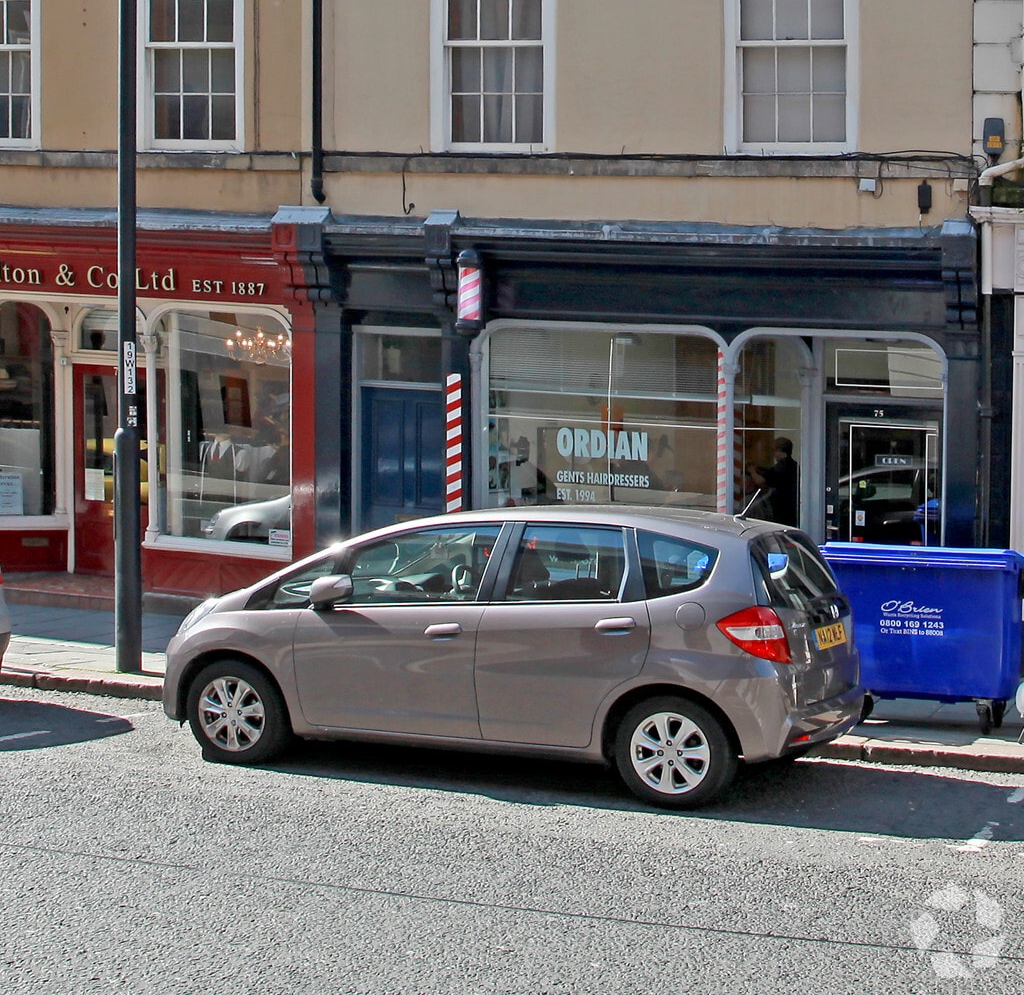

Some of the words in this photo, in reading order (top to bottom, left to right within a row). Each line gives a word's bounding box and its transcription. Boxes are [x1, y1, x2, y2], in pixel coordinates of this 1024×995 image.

[55, 263, 75, 287] &
[135, 267, 176, 291] Ltd
[192, 279, 223, 294] EST
[231, 281, 265, 296] 1887
[125, 342, 135, 394] 19W132
[873, 409, 884, 418] 75
[556, 427, 648, 462] ORDIAN
[556, 470, 585, 484] GENTS
[586, 471, 650, 488] HAIRDRESSERS
[556, 488, 573, 501] EST.
[576, 489, 596, 502] 1994
[880, 599, 943, 614] O'Brien
[879, 619, 902, 627] 0800
[904, 620, 920, 628] 169
[922, 621, 944, 629] 1243
